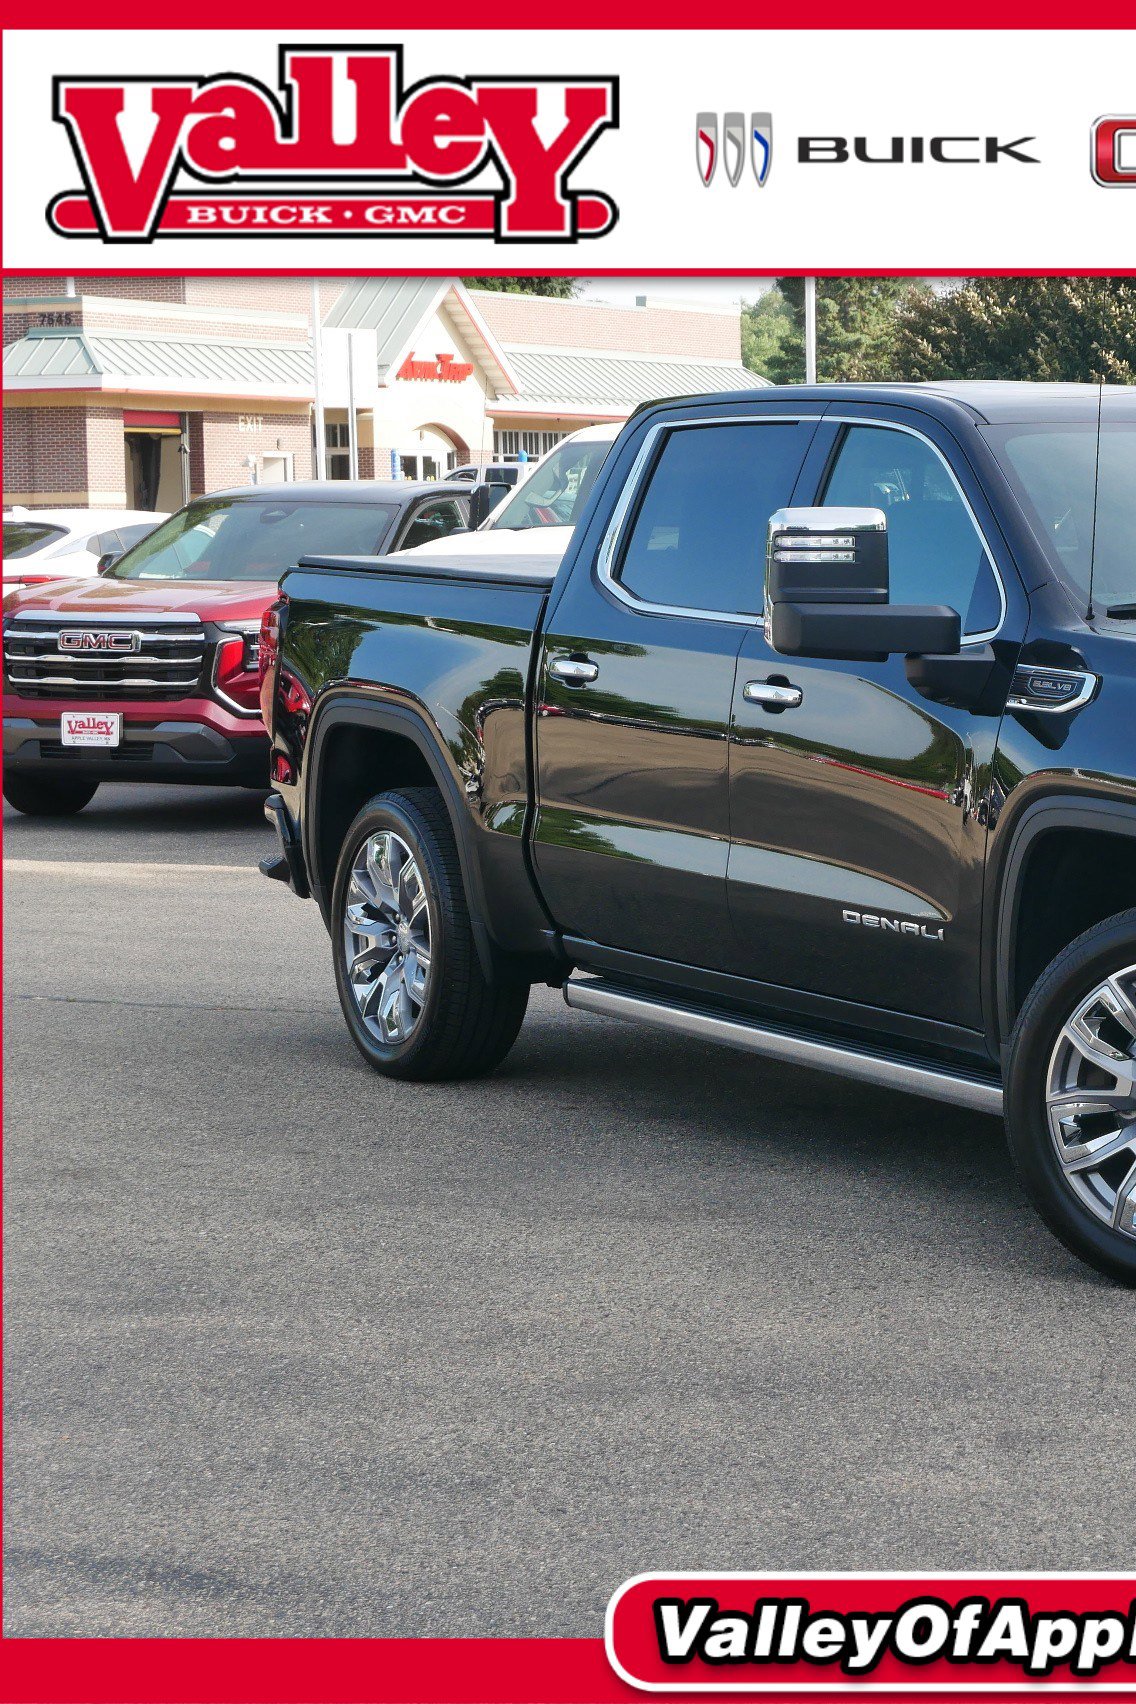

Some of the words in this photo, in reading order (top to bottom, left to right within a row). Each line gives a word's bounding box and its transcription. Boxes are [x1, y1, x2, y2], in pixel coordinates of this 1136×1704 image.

[239, 416, 263, 432] EXIT
[61, 633, 132, 649] GMC
[842, 909, 945, 941] DENALI
